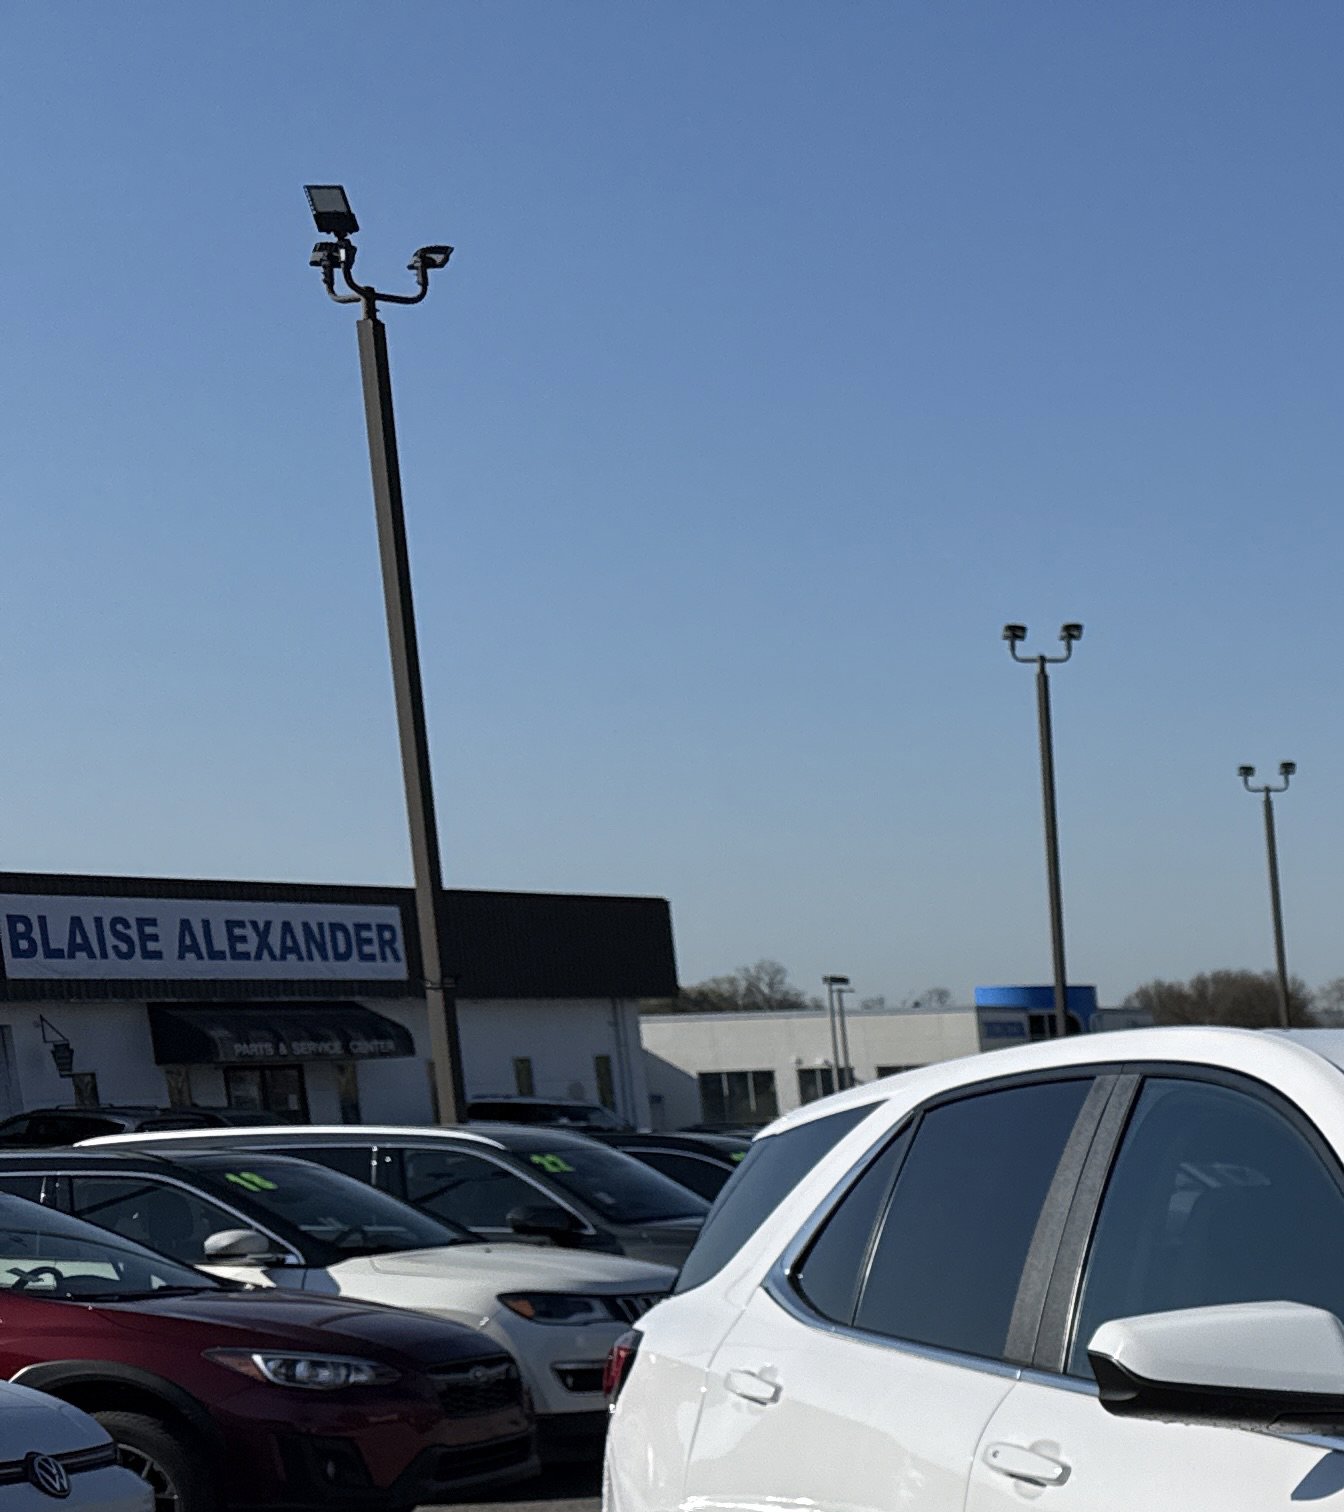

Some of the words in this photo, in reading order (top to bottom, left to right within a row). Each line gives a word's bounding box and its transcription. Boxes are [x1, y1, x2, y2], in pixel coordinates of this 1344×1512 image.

[5, 913, 163, 961] BLAISE
[177, 918, 402, 963] ALEXANDER
[233, 1041, 274, 1056] PARTS
[279, 1042, 288, 1056] &
[291, 1041, 342, 1055] SERVICE
[349, 1039, 395, 1054] CENTER
